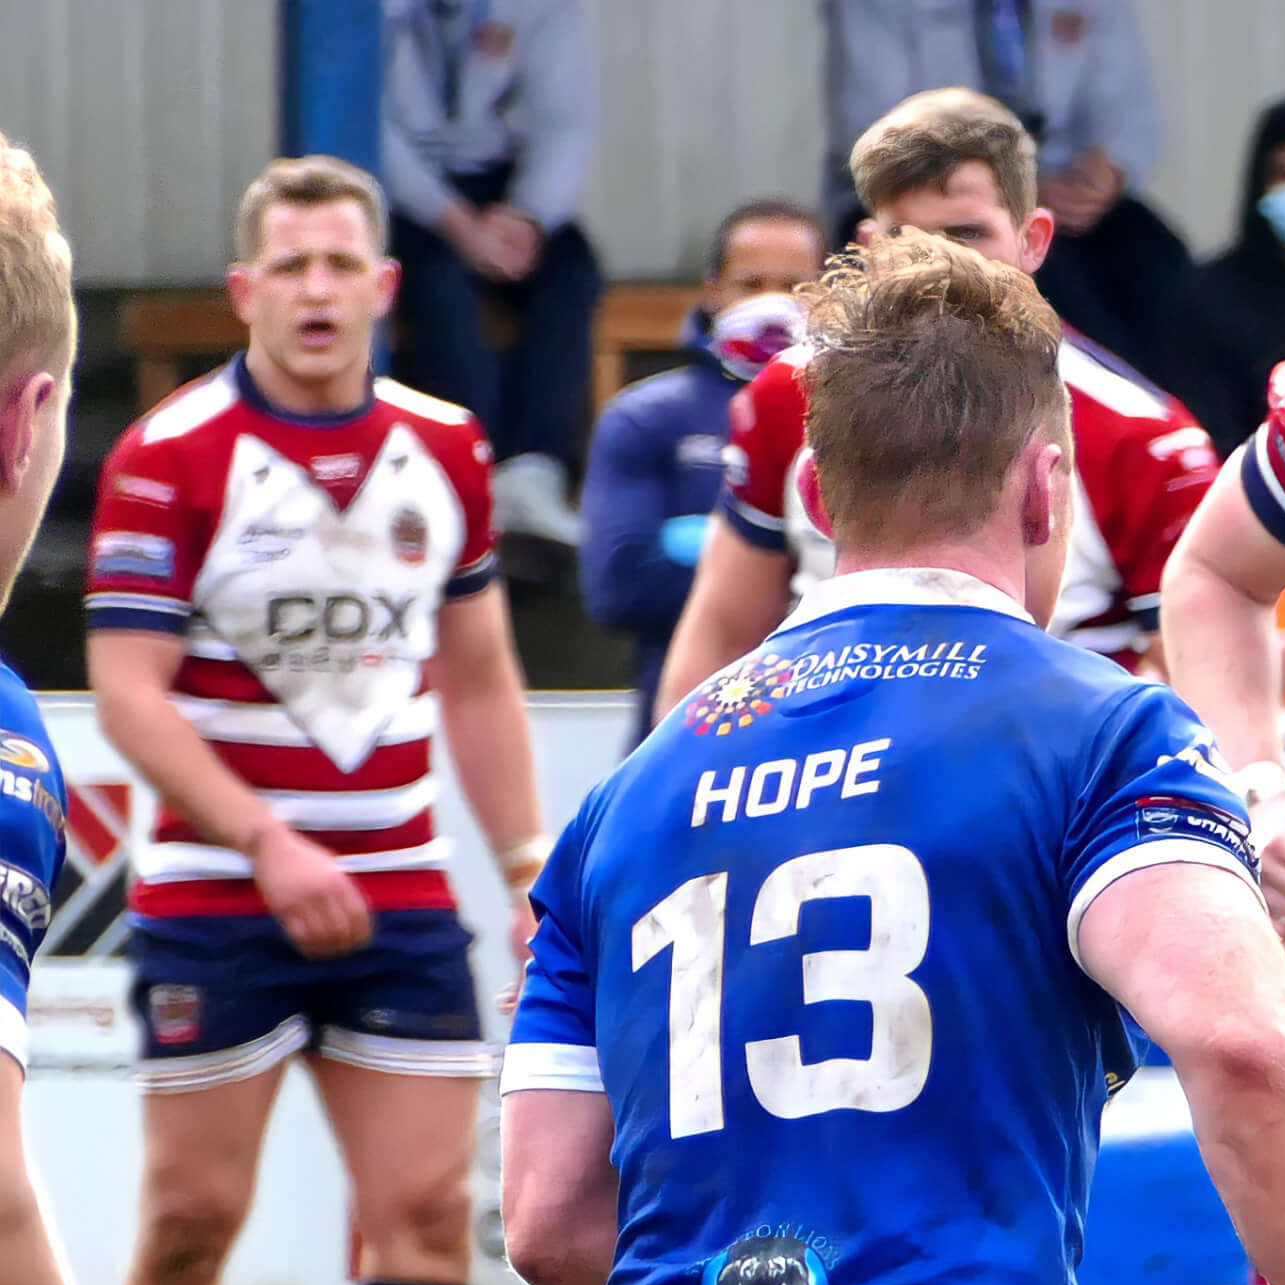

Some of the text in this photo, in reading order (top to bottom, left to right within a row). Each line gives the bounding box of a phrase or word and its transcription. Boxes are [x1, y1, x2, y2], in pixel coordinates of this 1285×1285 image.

[266, 590, 417, 642] CDX
[783, 662, 981, 698] TECHNOLOGIES
[791, 641, 988, 680] DAISYMILL
[691, 738, 892, 828] HOPE
[632, 843, 932, 1140] 13
